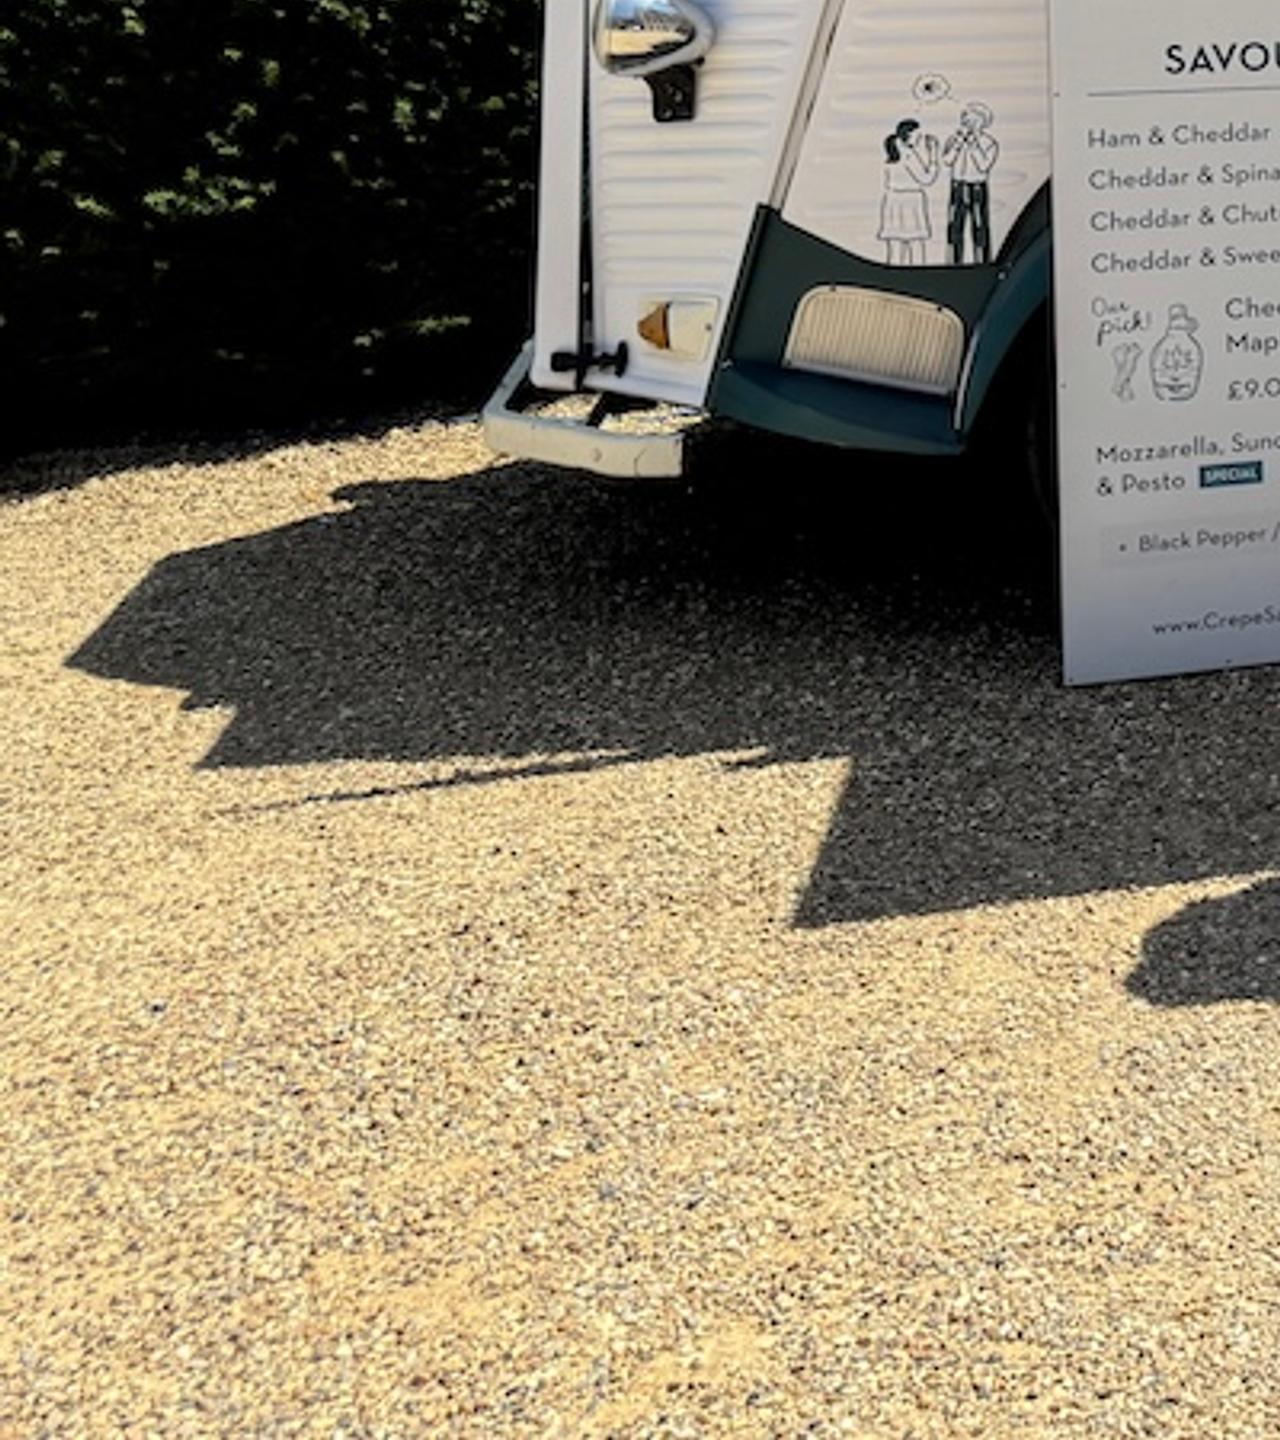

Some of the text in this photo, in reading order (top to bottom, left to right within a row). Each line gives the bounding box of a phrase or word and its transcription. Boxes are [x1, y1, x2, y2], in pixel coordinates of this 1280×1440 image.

[1088, 122, 1271, 148] Ham & Cheddar
[1088, 166, 1189, 190] Cheddar
[1197, 166, 1213, 184] &
[1090, 208, 1190, 232] Cheddar
[1198, 206, 1214, 225] &
[1091, 249, 1191, 273] Cheddar
[1200, 248, 1214, 266] &
[1097, 436, 1224, 464] Mozzarella,
[1097, 474, 1185, 496] & Pesto
[1139, 532, 1191, 552] Black
[1197, 529, 1266, 548] Pepper
[1271, 522, 1280, 542] /
